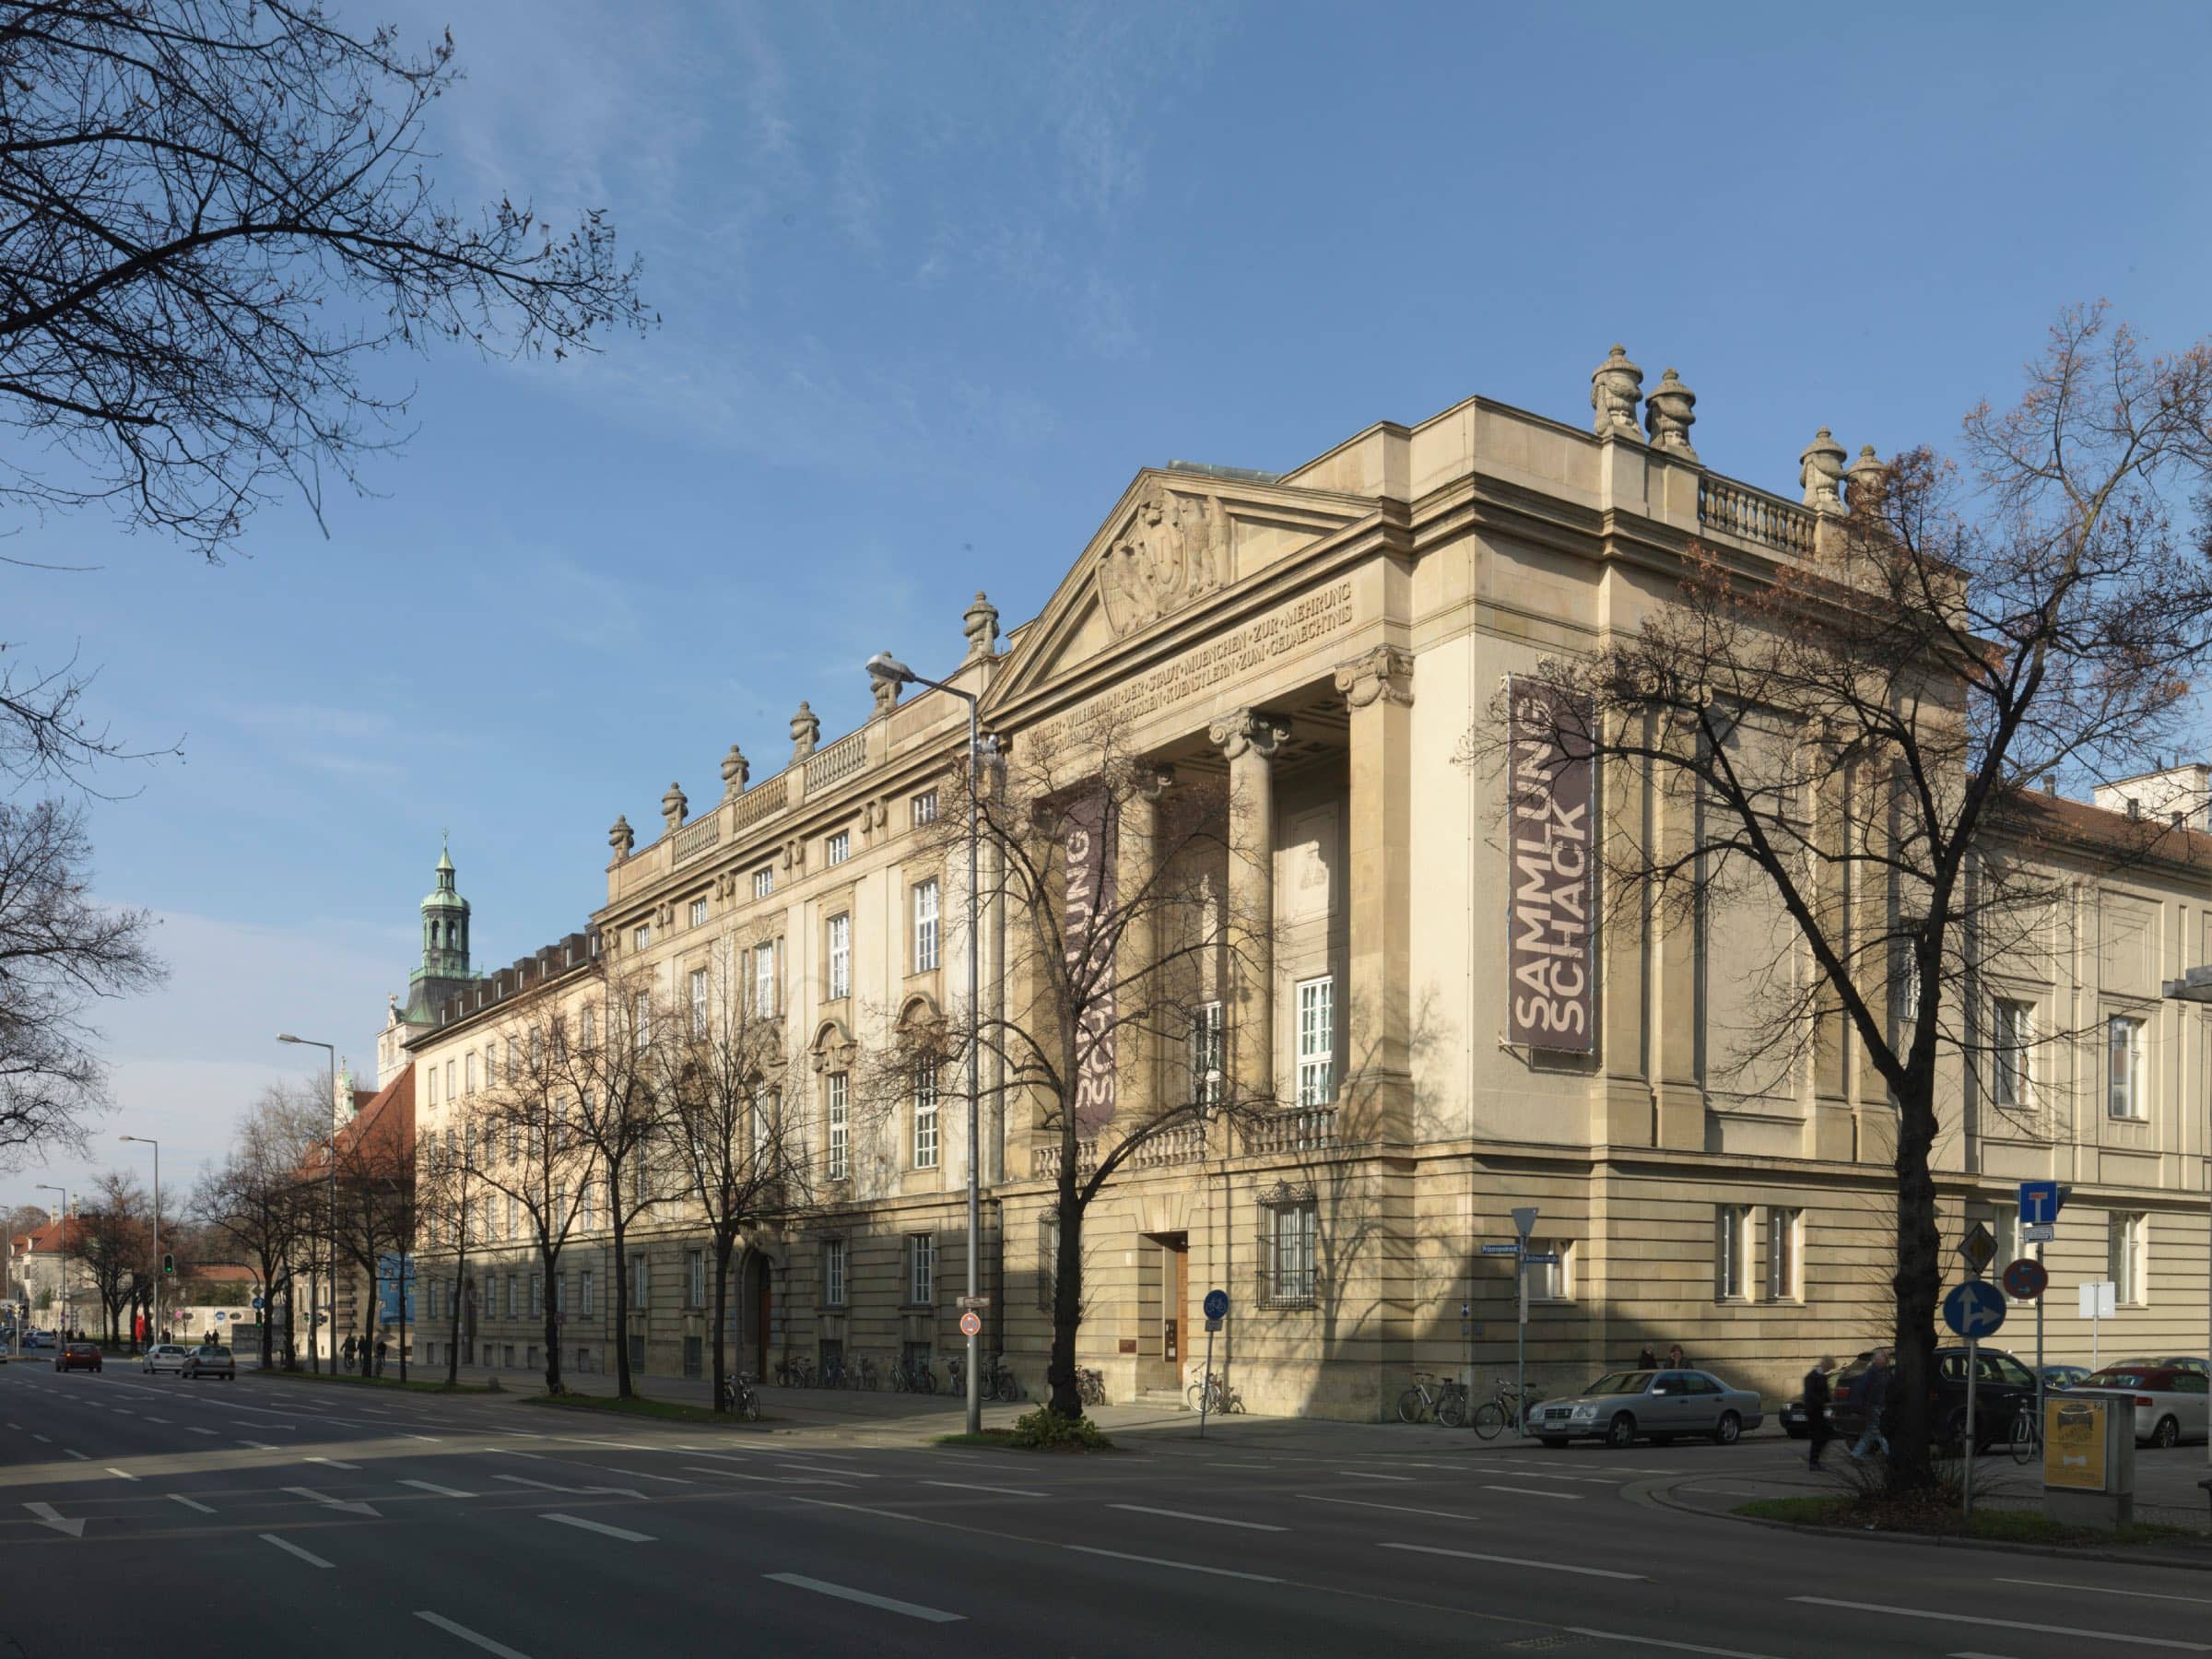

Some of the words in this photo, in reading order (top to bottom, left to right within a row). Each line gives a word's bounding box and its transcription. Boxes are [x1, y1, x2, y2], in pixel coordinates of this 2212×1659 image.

[1124, 682, 1144, 704] DER
[1149, 664, 1180, 692] STADT
[1185, 631, 1247, 677] MUENCHEN
[1253, 618, 1278, 643] ZUR
[1286, 582, 1351, 629] MEHRUNG
[1166, 657, 1235, 704] KUENSTLERN
[1240, 644, 1265, 671] ZUM
[1270, 604, 1352, 656] GEDAECHTNIS
[1516, 698, 1553, 1032] SAMMLUNG
[1550, 803, 1585, 1035] SCHACK
